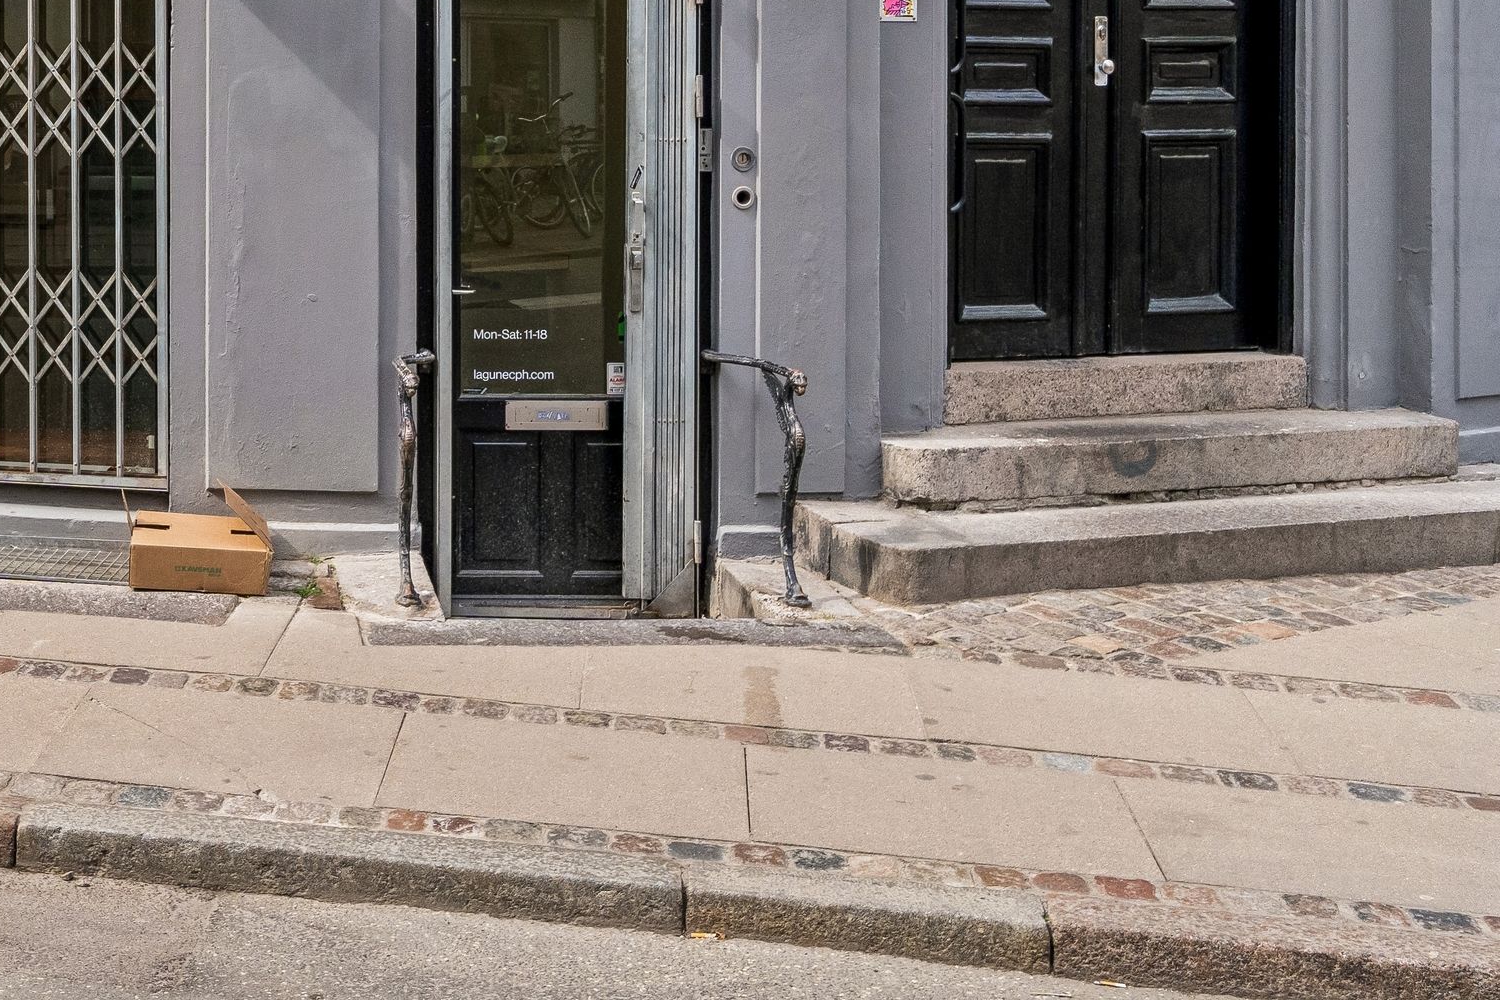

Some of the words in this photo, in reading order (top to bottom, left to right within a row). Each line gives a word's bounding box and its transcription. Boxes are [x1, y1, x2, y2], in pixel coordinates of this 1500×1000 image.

[473, 329, 522, 340] Mon-Sat:
[524, 329, 548, 340] 11-18
[473, 369, 554, 381] lagunecph.com
